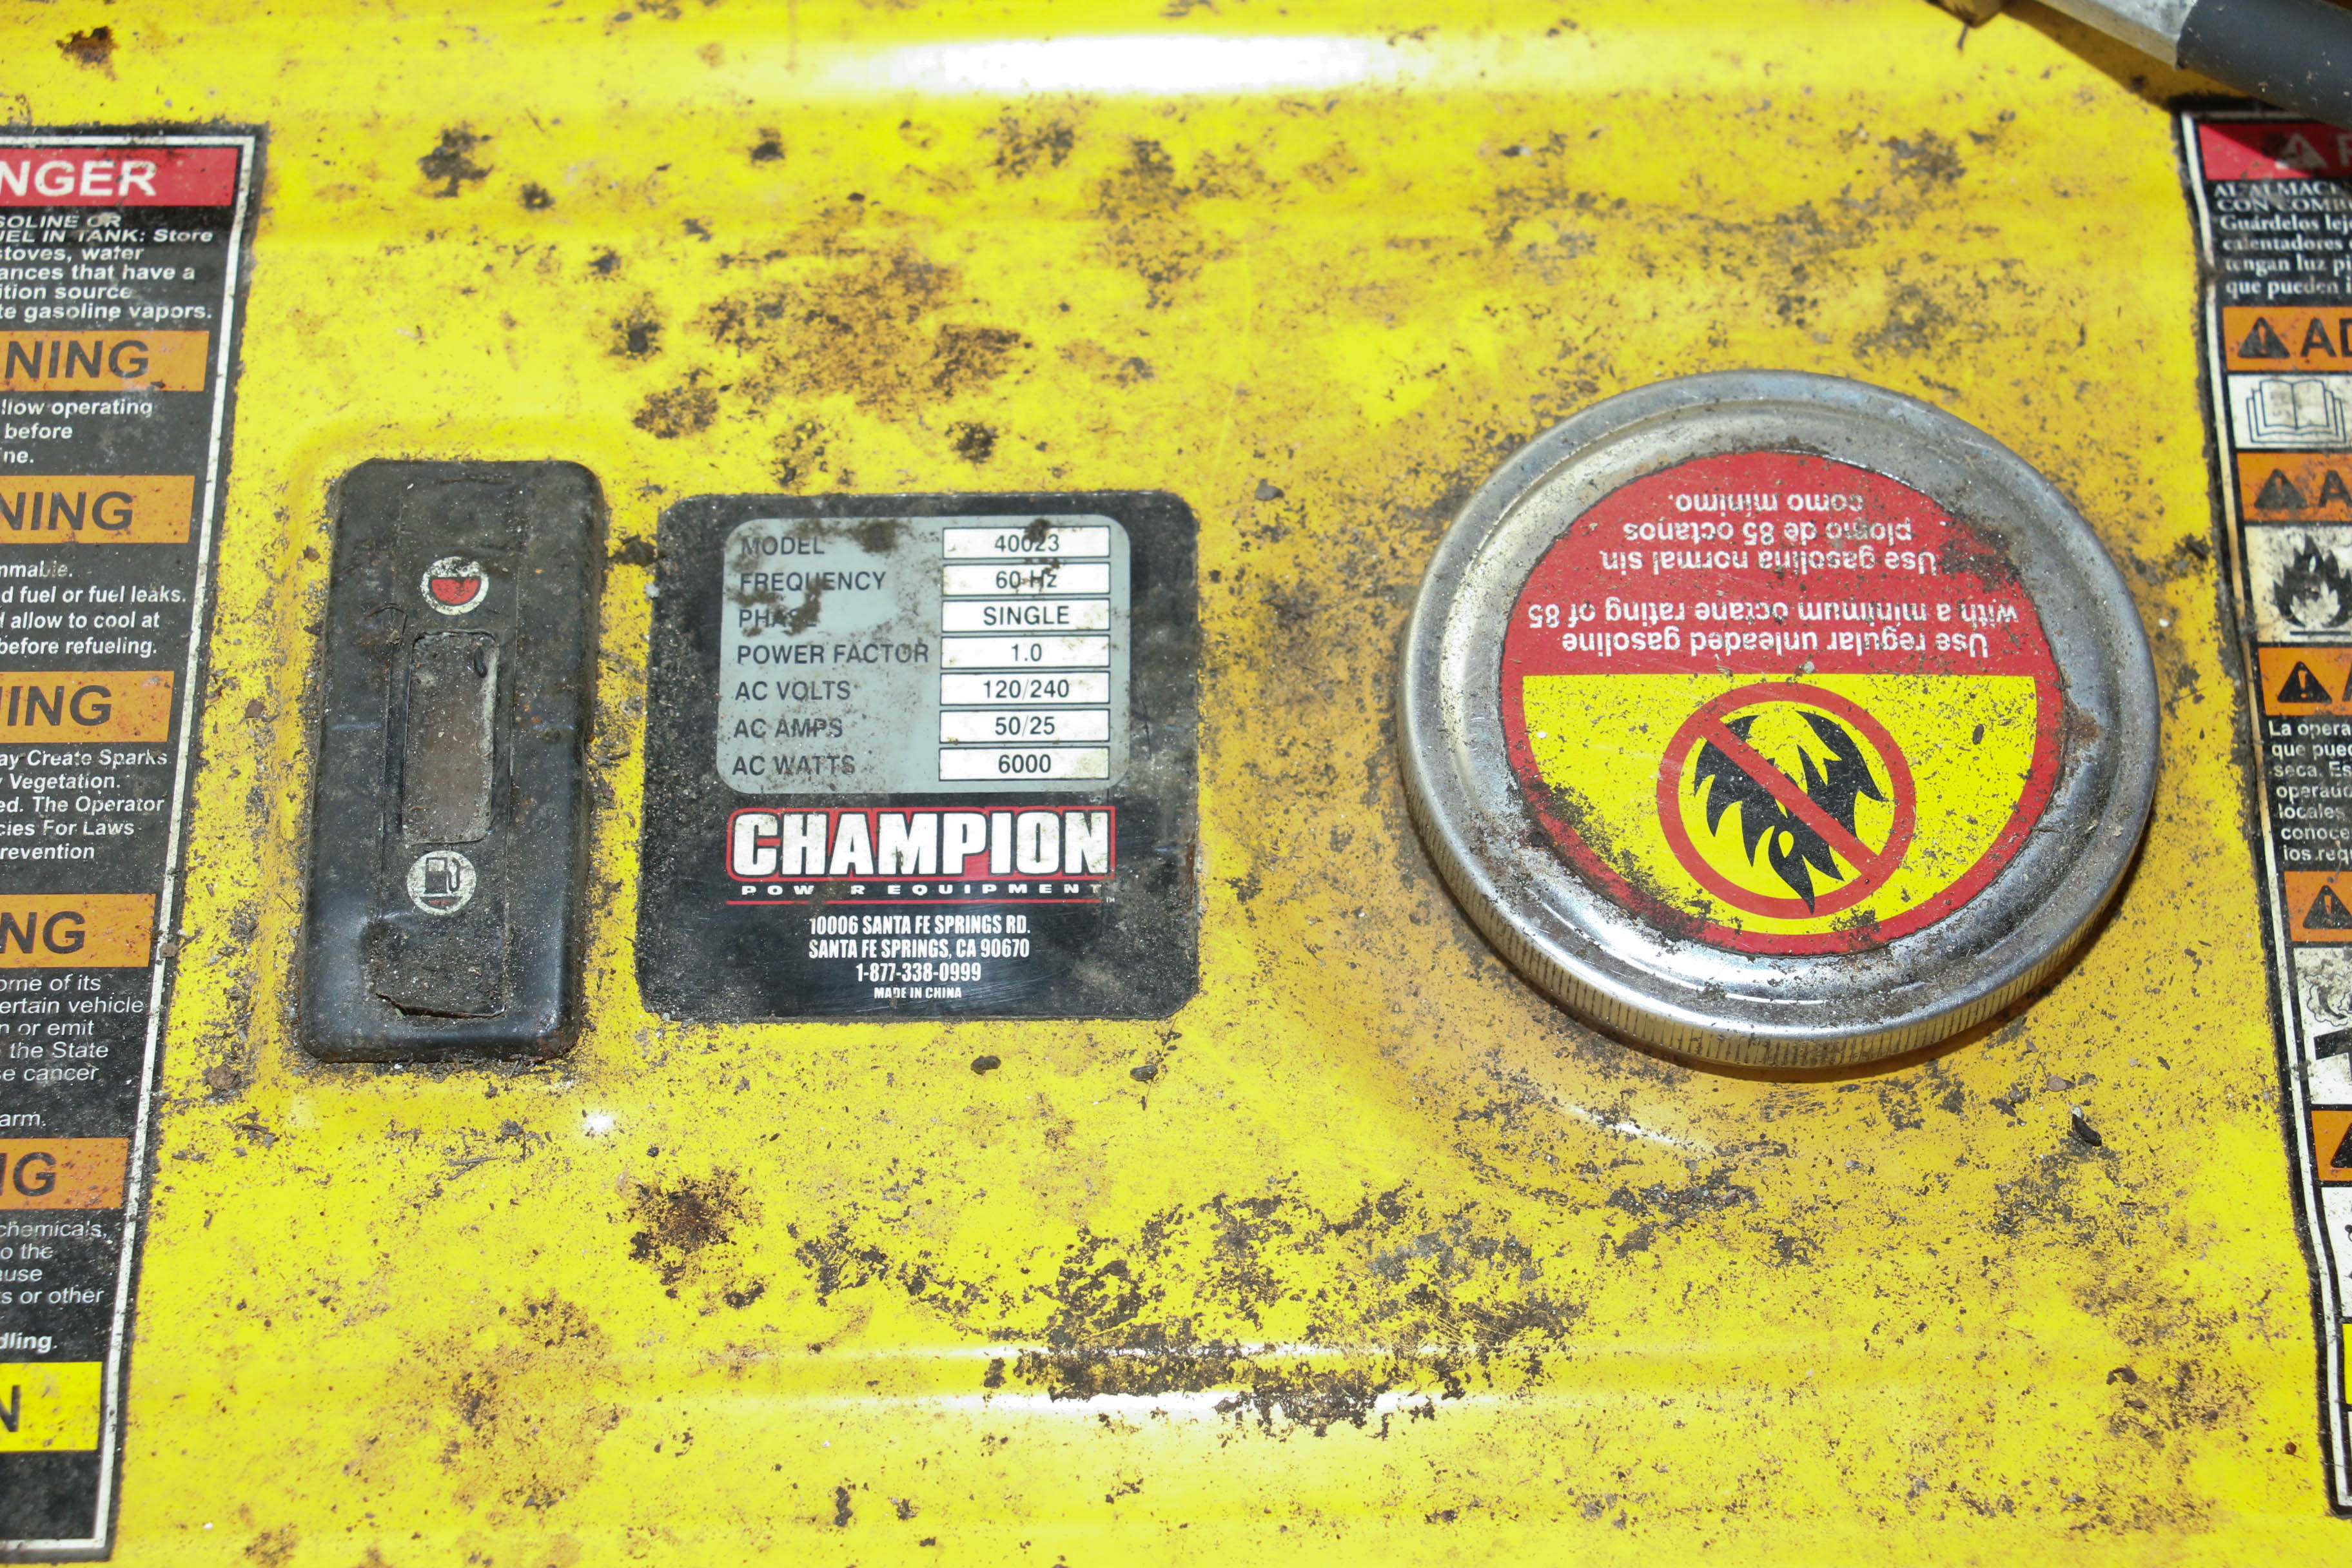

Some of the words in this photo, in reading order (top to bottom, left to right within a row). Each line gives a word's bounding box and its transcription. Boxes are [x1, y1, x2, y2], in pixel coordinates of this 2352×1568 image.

[0, 161, 157, 196] NGER
[2217, 197, 2269, 212] CON
[2275, 196, 2352, 212] COMB
[2220, 213, 2319, 231] Guárdelos
[42, 230, 66, 242] IN
[76, 229, 146, 242] TANK:
[153, 230, 213, 242] Store
[2222, 233, 2343, 251] calentadores
[0, 246, 72, 263] toves,
[81, 246, 144, 260] water
[2224, 257, 2291, 277] tengan
[2296, 252, 2326, 271] luz
[0, 268, 63, 280] ances
[72, 264, 114, 280] that
[122, 264, 176, 280] have
[182, 268, 195, 280] a
[55, 287, 131, 299] source
[2226, 280, 2261, 300] que
[2268, 275, 2339, 300] pueden
[24, 303, 121, 322] gasoline
[129, 305, 212, 321] vapors.
[5, 340, 149, 379] NING
[1, 398, 44, 415] llow
[51, 398, 153, 418] operating
[5, 423, 73, 439] before
[0, 447, 34, 464] ne.
[0, 491, 133, 531] NING
[1669, 494, 1778, 517] mínimo.
[1787, 494, 1863, 511] como
[1623, 522, 1734, 544] octanos
[1743, 522, 1774, 545] 85
[1784, 523, 1817, 545] de
[1826, 517, 1912, 545] plomo
[742, 536, 825, 555] MODEL
[995, 534, 1059, 552] 40023
[1600, 551, 1643, 575] sin
[1652, 550, 1749, 574] normal
[1758, 545, 1875, 574] gasolina
[1885, 550, 1936, 576] Use
[741, 571, 886, 591] FREQUENCY
[996, 571, 1021, 589] 60
[1030, 570, 1057, 588] Hz
[20, 585, 57, 603] fuel
[62, 590, 83, 603] or
[89, 585, 124, 603] fuel
[131, 586, 186, 603] leaks.
[10, 611, 63, 629] allow
[68, 612, 88, 629] to
[93, 611, 135, 628] cool
[142, 612, 160, 628] at
[740, 609, 817, 628] PHA
[983, 605, 1070, 625] SINGLE
[1529, 604, 1560, 628] 85
[1568, 603, 1596, 628] of
[1605, 596, 1686, 627] rating
[1695, 602, 1788, 625] octane
[1798, 602, 1926, 627] minimum
[1936, 603, 1951, 622] a
[1961, 602, 2018, 630] with
[0, 637, 59, 654] before
[66, 636, 157, 658] refueling.
[1562, 625, 1680, 656] gasoline
[1690, 632, 1817, 656] unleaded
[1827, 625, 1925, 656] regular
[1936, 632, 1988, 658] Use
[737, 645, 825, 664] POWER
[834, 644, 928, 663] FACTOR
[1011, 643, 1042, 662] 1.0
[735, 681, 768, 701] AC
[776, 680, 851, 701] VOLTS
[983, 679, 1069, 700] 120/240
[0, 685, 112, 726] ING
[734, 718, 767, 738] AC
[774, 718, 843, 738] AMPS
[995, 716, 1055, 736] 50/25
[2269, 720, 2292, 738] La
[0, 753, 19, 770] ay
[27, 749, 92, 766] Create
[99, 749, 168, 769] Sparks
[2271, 744, 2306, 760] que
[732, 756, 765, 775] AC
[774, 755, 855, 775] WATTS
[999, 754, 1051, 773] 6000
[10, 774, 121, 793] Vegetation.
[32, 796, 68, 812] The
[75, 796, 164, 816] Operator
[2278, 803, 2345, 820] locales
[43, 819, 77, 836] For
[83, 821, 135, 836] Laws
[0, 843, 95, 859] revention
[732, 812, 1109, 876] CHAMPION
[2284, 845, 2311, 861] los
[2318, 848, 2352, 865] req
[741, 885, 865, 896] POWR
[888, 883, 1102, 895] EQUIPMENT
[0, 912, 86, 954] NG
[810, 916, 858, 935] 10006
[863, 916, 911, 934] SANTA
[916, 916, 930, 934] FE
[935, 915, 1002, 934] SPRINGS
[1006, 915, 1030, 934] RD.
[808, 939, 858, 959] SANTA
[861, 939, 877, 958] FE
[881, 939, 952, 959] SPRINGS,
[956, 939, 976, 957] CA
[981, 939, 1030, 957] 90670
[50, 974, 74, 991] of
[78, 974, 101, 991] its
[856, 963, 981, 982] 1-877-338-0999
[874, 987, 906, 999] MADE
[910, 987, 921, 998] IN
[925, 987, 962, 998] CHINA
[0, 997, 60, 1014] ertain
[68, 996, 144, 1014] vehicle
[18, 1023, 41, 1035] or
[47, 1019, 94, 1035] emit
[10, 1042, 43, 1059] the
[52, 1041, 109, 1059] State
[0, 1068, 15, 1081] e
[24, 1067, 99, 1081] cancer
[0, 1112, 46, 1127] arm.
[0, 1152, 56, 1197] G
[21, 1243, 53, 1259] the
[20, 1291, 43, 1304] or
[48, 1288, 104, 1304] other
[0, 1332, 57, 1353] dling.
